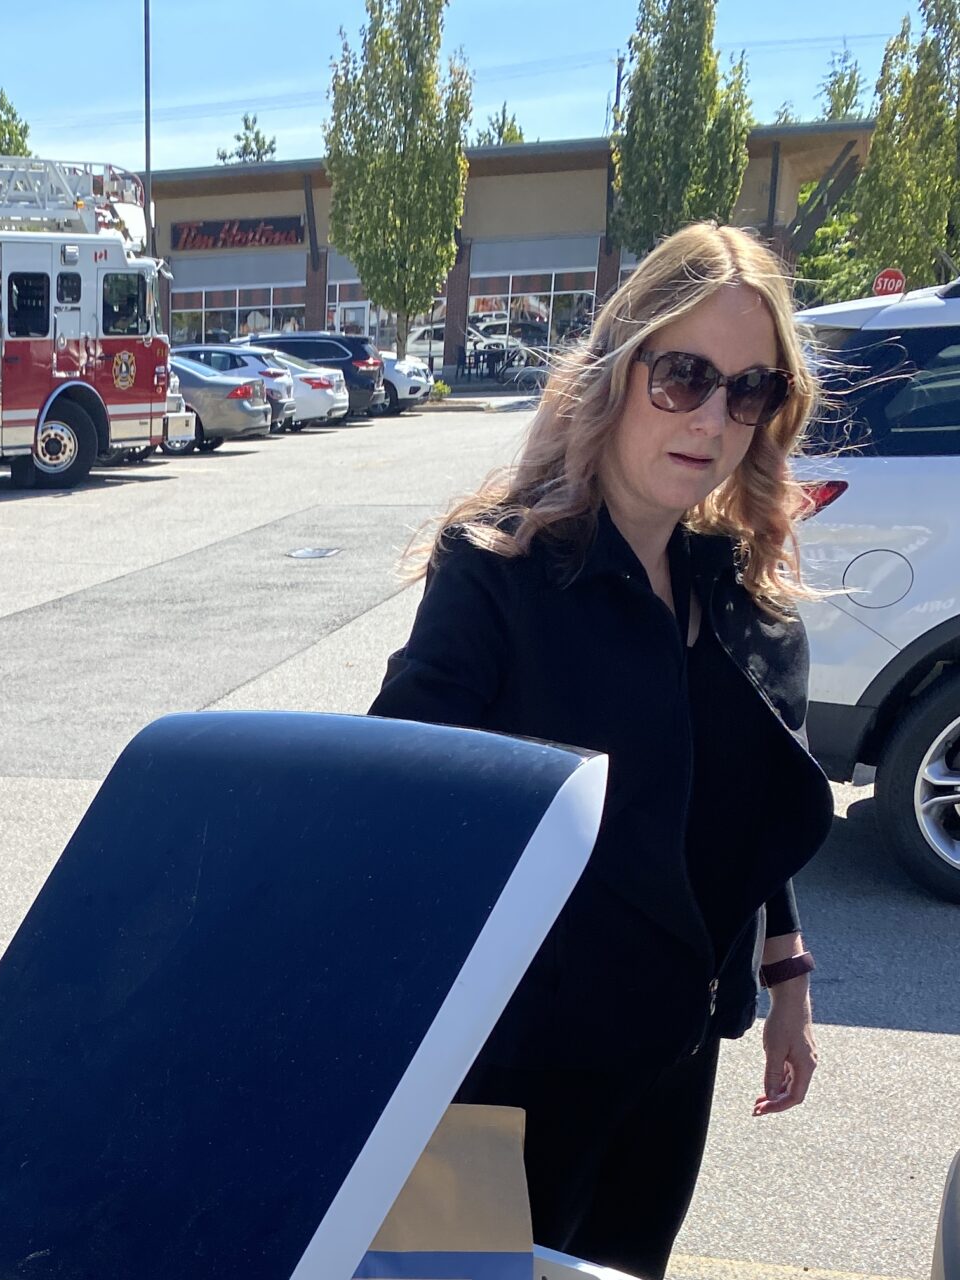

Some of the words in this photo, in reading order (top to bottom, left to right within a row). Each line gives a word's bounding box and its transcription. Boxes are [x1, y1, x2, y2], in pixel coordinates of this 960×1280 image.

[176, 222, 213, 251] Tim
[217, 219, 297, 248] Hortons
[876, 277, 903, 291] STOP
